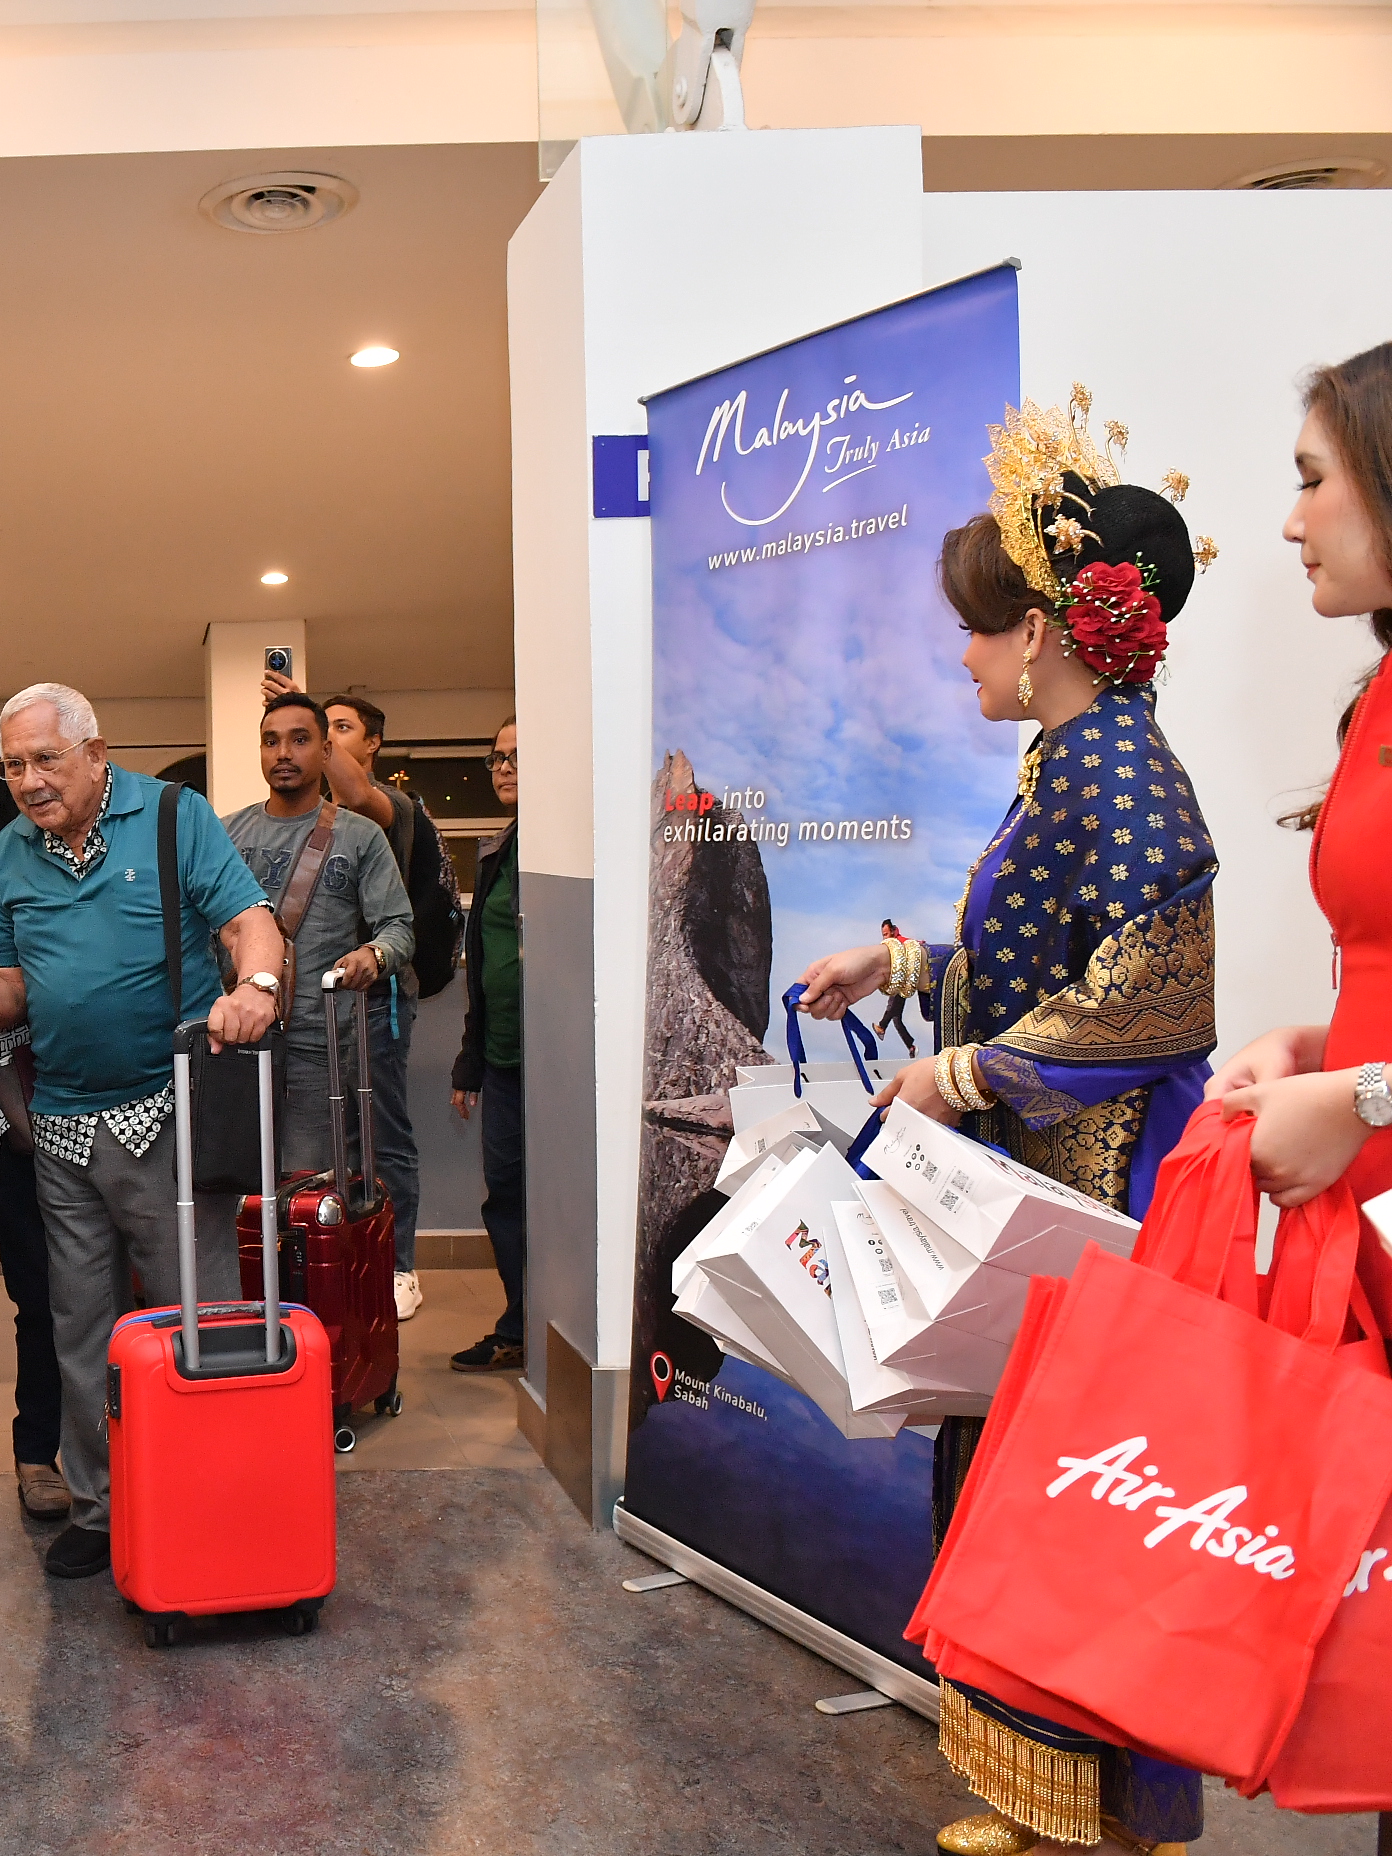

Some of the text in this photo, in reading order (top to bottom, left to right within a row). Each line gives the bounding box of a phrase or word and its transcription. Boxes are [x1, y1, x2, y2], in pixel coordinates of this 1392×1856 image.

[696, 375, 914, 526] Malaysia
[824, 422, 931, 474] Truly Asia
[708, 503, 908, 571] www.malaysia.travel
[722, 786, 765, 810] into
[664, 815, 912, 847] exhilarating moments
[674, 1368, 768, 1422] Mount Kinabalu,
[674, 1384, 709, 1411] Sabah
